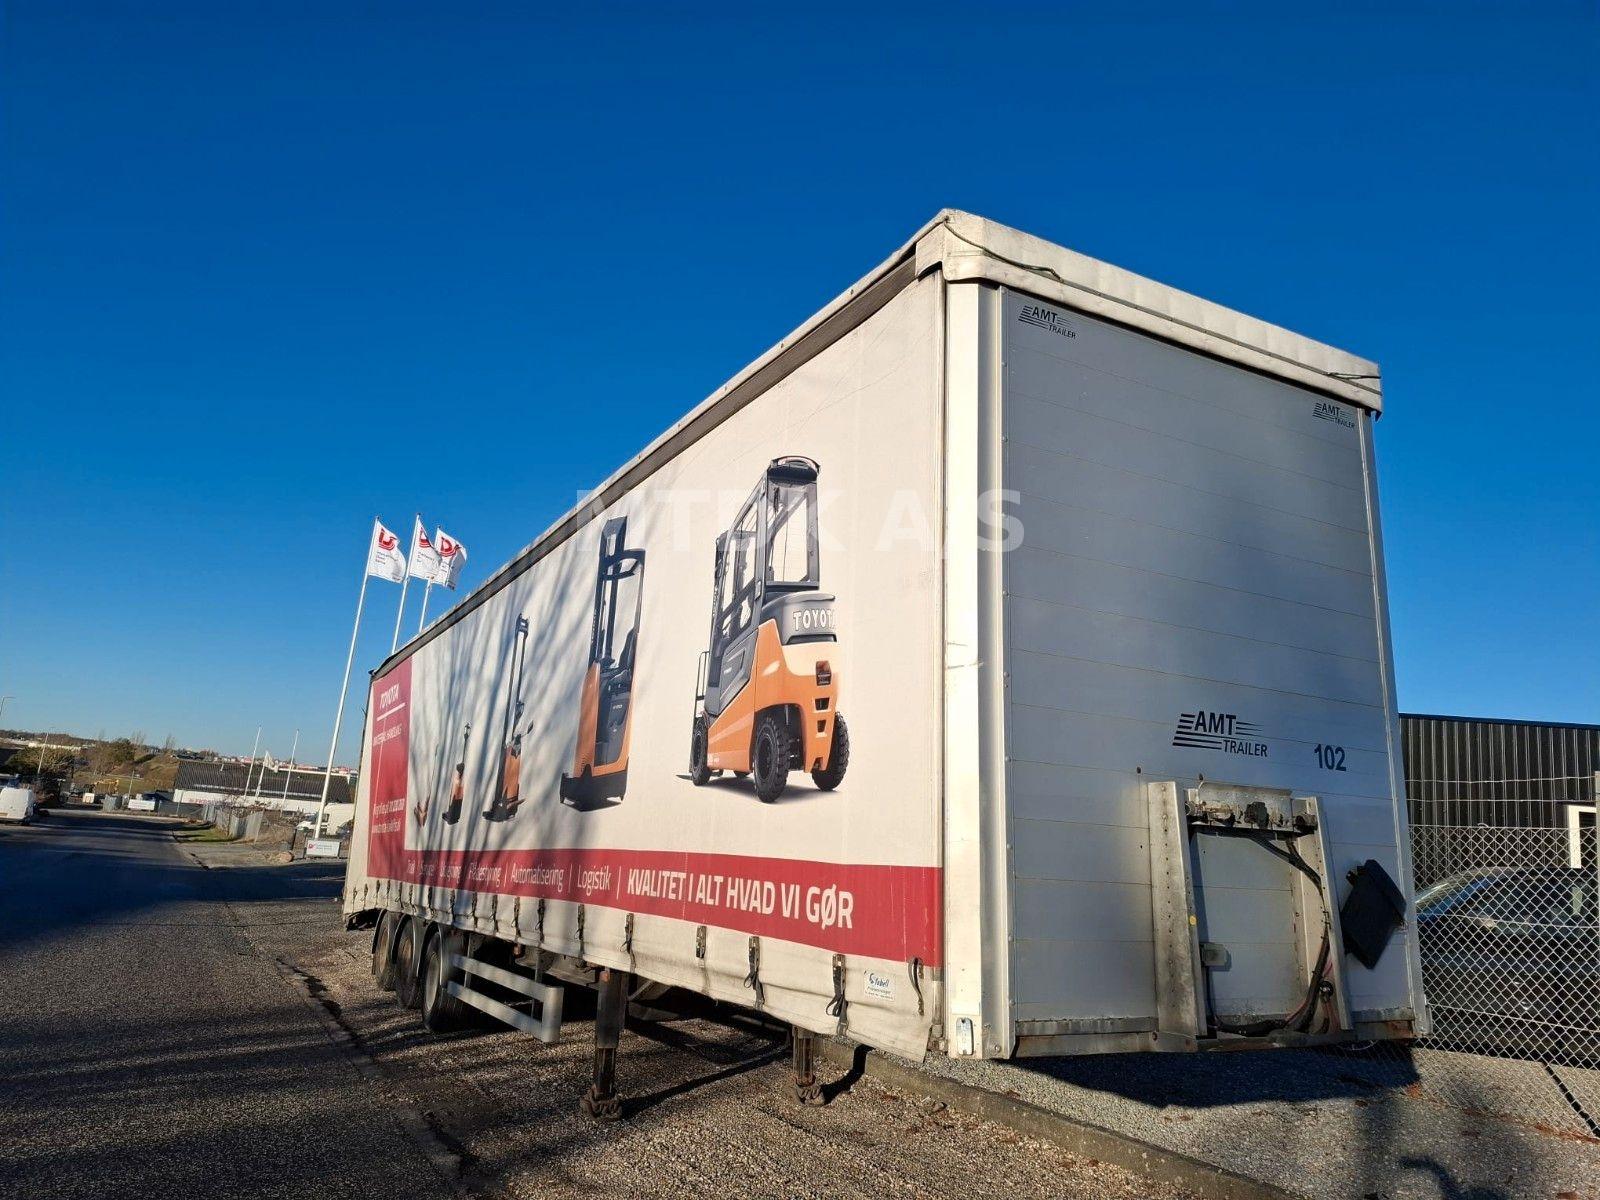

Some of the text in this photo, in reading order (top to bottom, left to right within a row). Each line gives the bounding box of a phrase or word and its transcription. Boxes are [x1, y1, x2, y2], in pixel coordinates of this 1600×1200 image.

[1032, 306, 1058, 323] AMT
[1048, 323, 1077, 340] TRAILER
[1322, 403, 1340, 417] AMT
[1194, 710, 1237, 736] AMT
[1222, 739, 1269, 758] TRAILER
[1313, 743, 1347, 772] 102
[511, 862, 564, 893] Automatisering
[577, 864, 612, 896] Logistik
[627, 868, 687, 901] KVALITET
[688, 873, 695, 903] I
[695, 874, 724, 907] ALT
[726, 877, 776, 915] HVAD
[780, 883, 800, 920] VI
[806, 884, 855, 930] GØR
